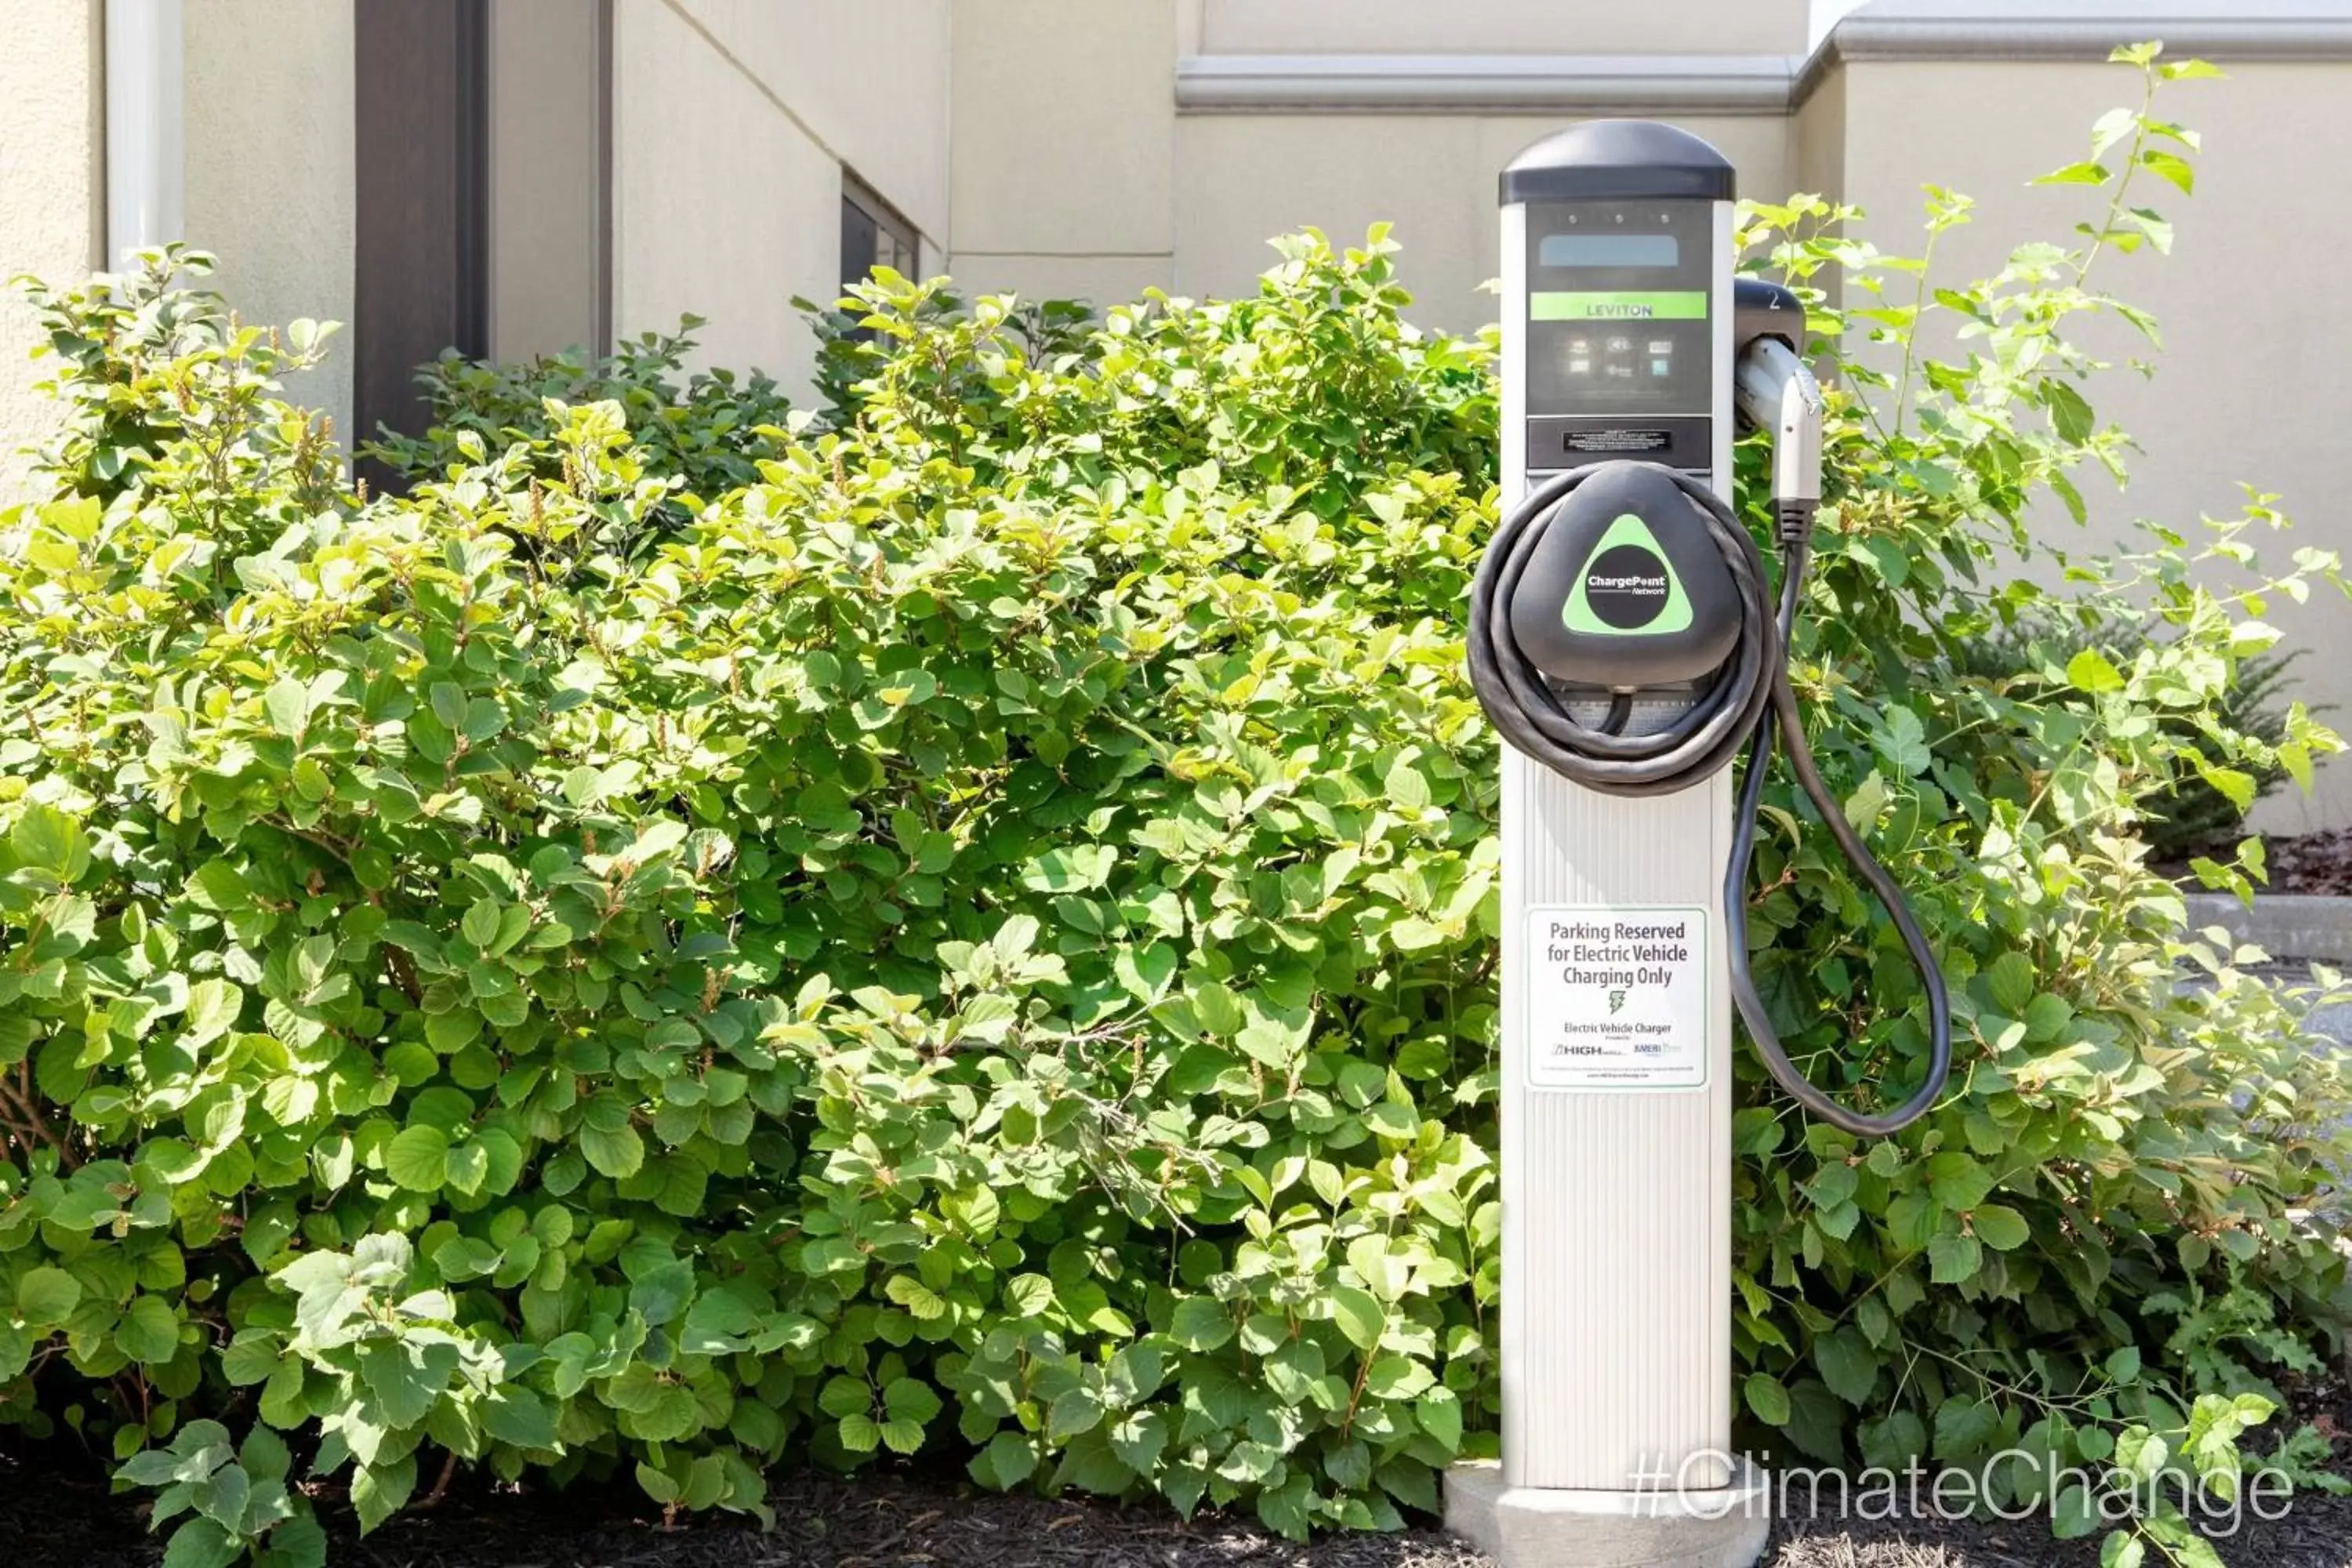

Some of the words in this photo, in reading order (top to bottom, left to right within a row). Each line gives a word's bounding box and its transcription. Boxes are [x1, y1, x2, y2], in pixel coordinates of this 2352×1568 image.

[1769, 290, 1780, 310] 2
[1586, 303, 1653, 317] LEVITON
[1588, 576, 1665, 588] ChargePoint
[1550, 922, 1610, 943] Parking
[1615, 922, 1685, 939] Reserved
[1548, 945, 1570, 961] for
[1574, 945, 1629, 961] Electric
[1632, 945, 1687, 961] Vehicle
[1563, 967, 1633, 988] Charging
[1638, 967, 1672, 988] Only
[1564, 1022, 1598, 1033] Electric
[1599, 1022, 1632, 1033] Vehicle
[1635, 1022, 1671, 1035] Charger
